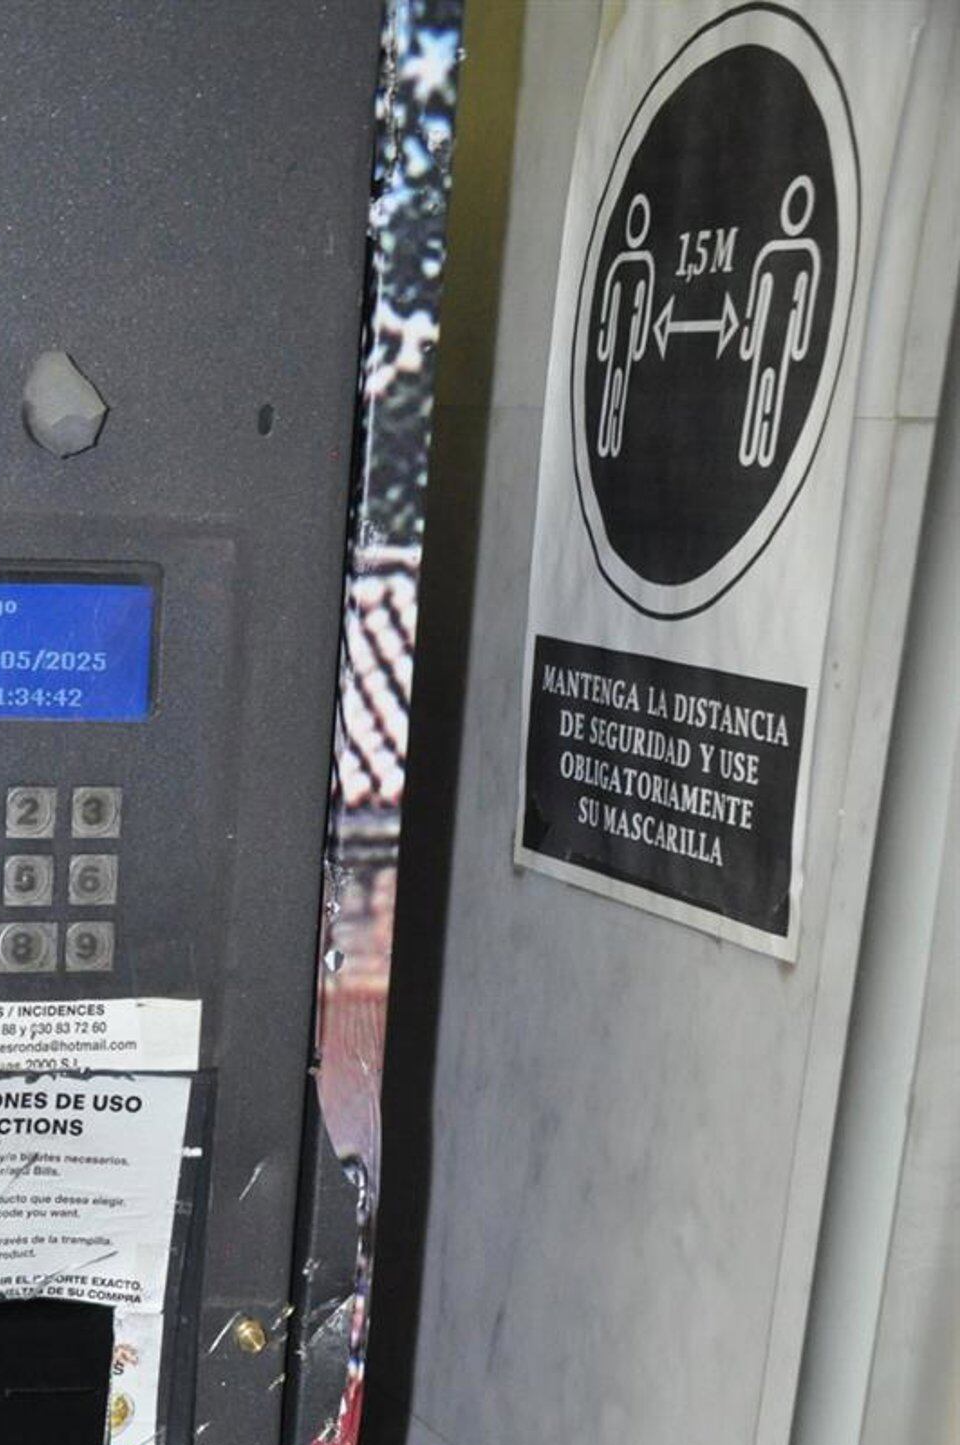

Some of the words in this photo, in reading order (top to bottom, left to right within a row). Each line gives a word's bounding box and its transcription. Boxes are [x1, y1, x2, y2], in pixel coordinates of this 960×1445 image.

[542, 664, 640, 714] MANTENGA
[647, 686, 669, 719] LA
[674, 693, 790, 747] DISTANCIA
[560, 709, 584, 740] DE
[590, 716, 691, 769] SEGURIDAD
[699, 743, 716, 774] Y
[720, 750, 760, 785] USE
[560, 751, 754, 830] OBLIGATORIAMENTE
[17, 797, 39, 826] 2
[82, 798, 102, 826] 3
[578, 796, 600, 828] SU
[603, 805, 724, 868] MASCARILLA
[14, 865, 36, 893] 5
[78, 865, 100, 893] 6
[11, 932, 34, 964] 8
[76, 931, 97, 960] 9
[18, 1004, 105, 1018] INCIDENCES
[75, 1021, 89, 1034] 72
[55, 1092, 86, 1111] DE
[93, 1093, 143, 1113] USO
[30, 1196, 52, 1208] que
[26, 1209, 47, 1220] you
[31, 1234, 46, 1245] de
[15, 1274, 29, 1285] EL
[32, 1273, 88, 1286] ORTE
[47, 1286, 64, 1296] DE
[67, 1287, 85, 1298] SU
